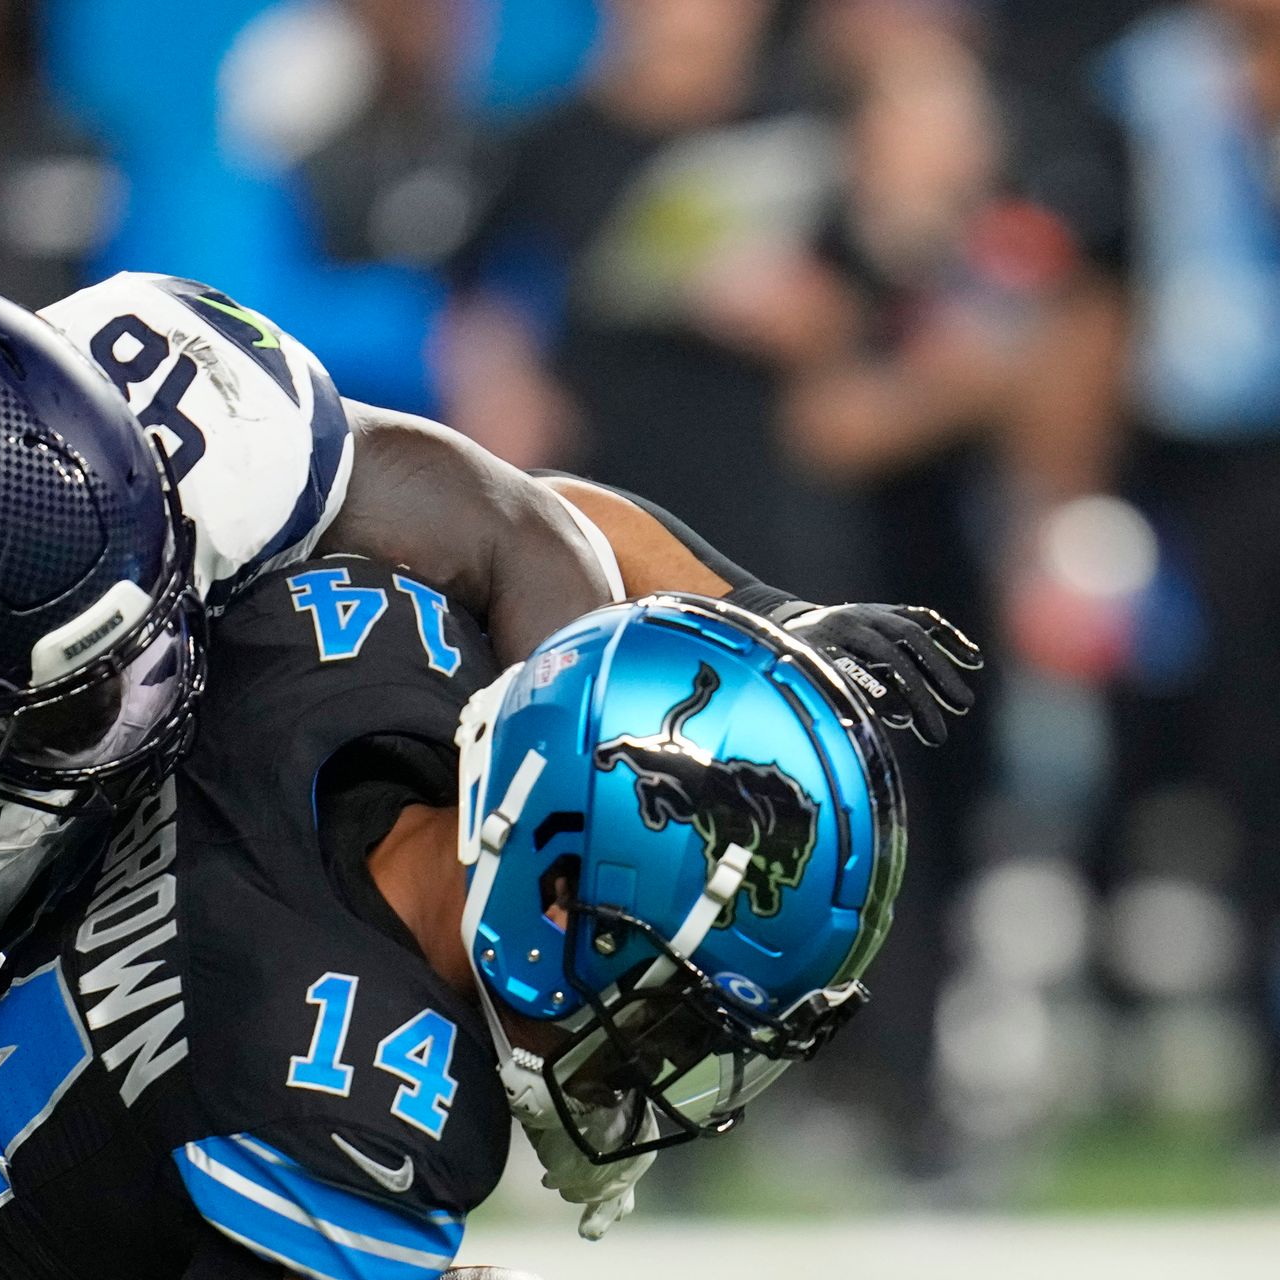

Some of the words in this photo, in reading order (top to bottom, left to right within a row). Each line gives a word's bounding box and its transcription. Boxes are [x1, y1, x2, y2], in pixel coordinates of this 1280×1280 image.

[286, 567, 462, 678] 14
[832, 656, 887, 699] ADIZERO
[75, 773, 189, 1108] BROWN
[286, 971, 459, 1141] 14
